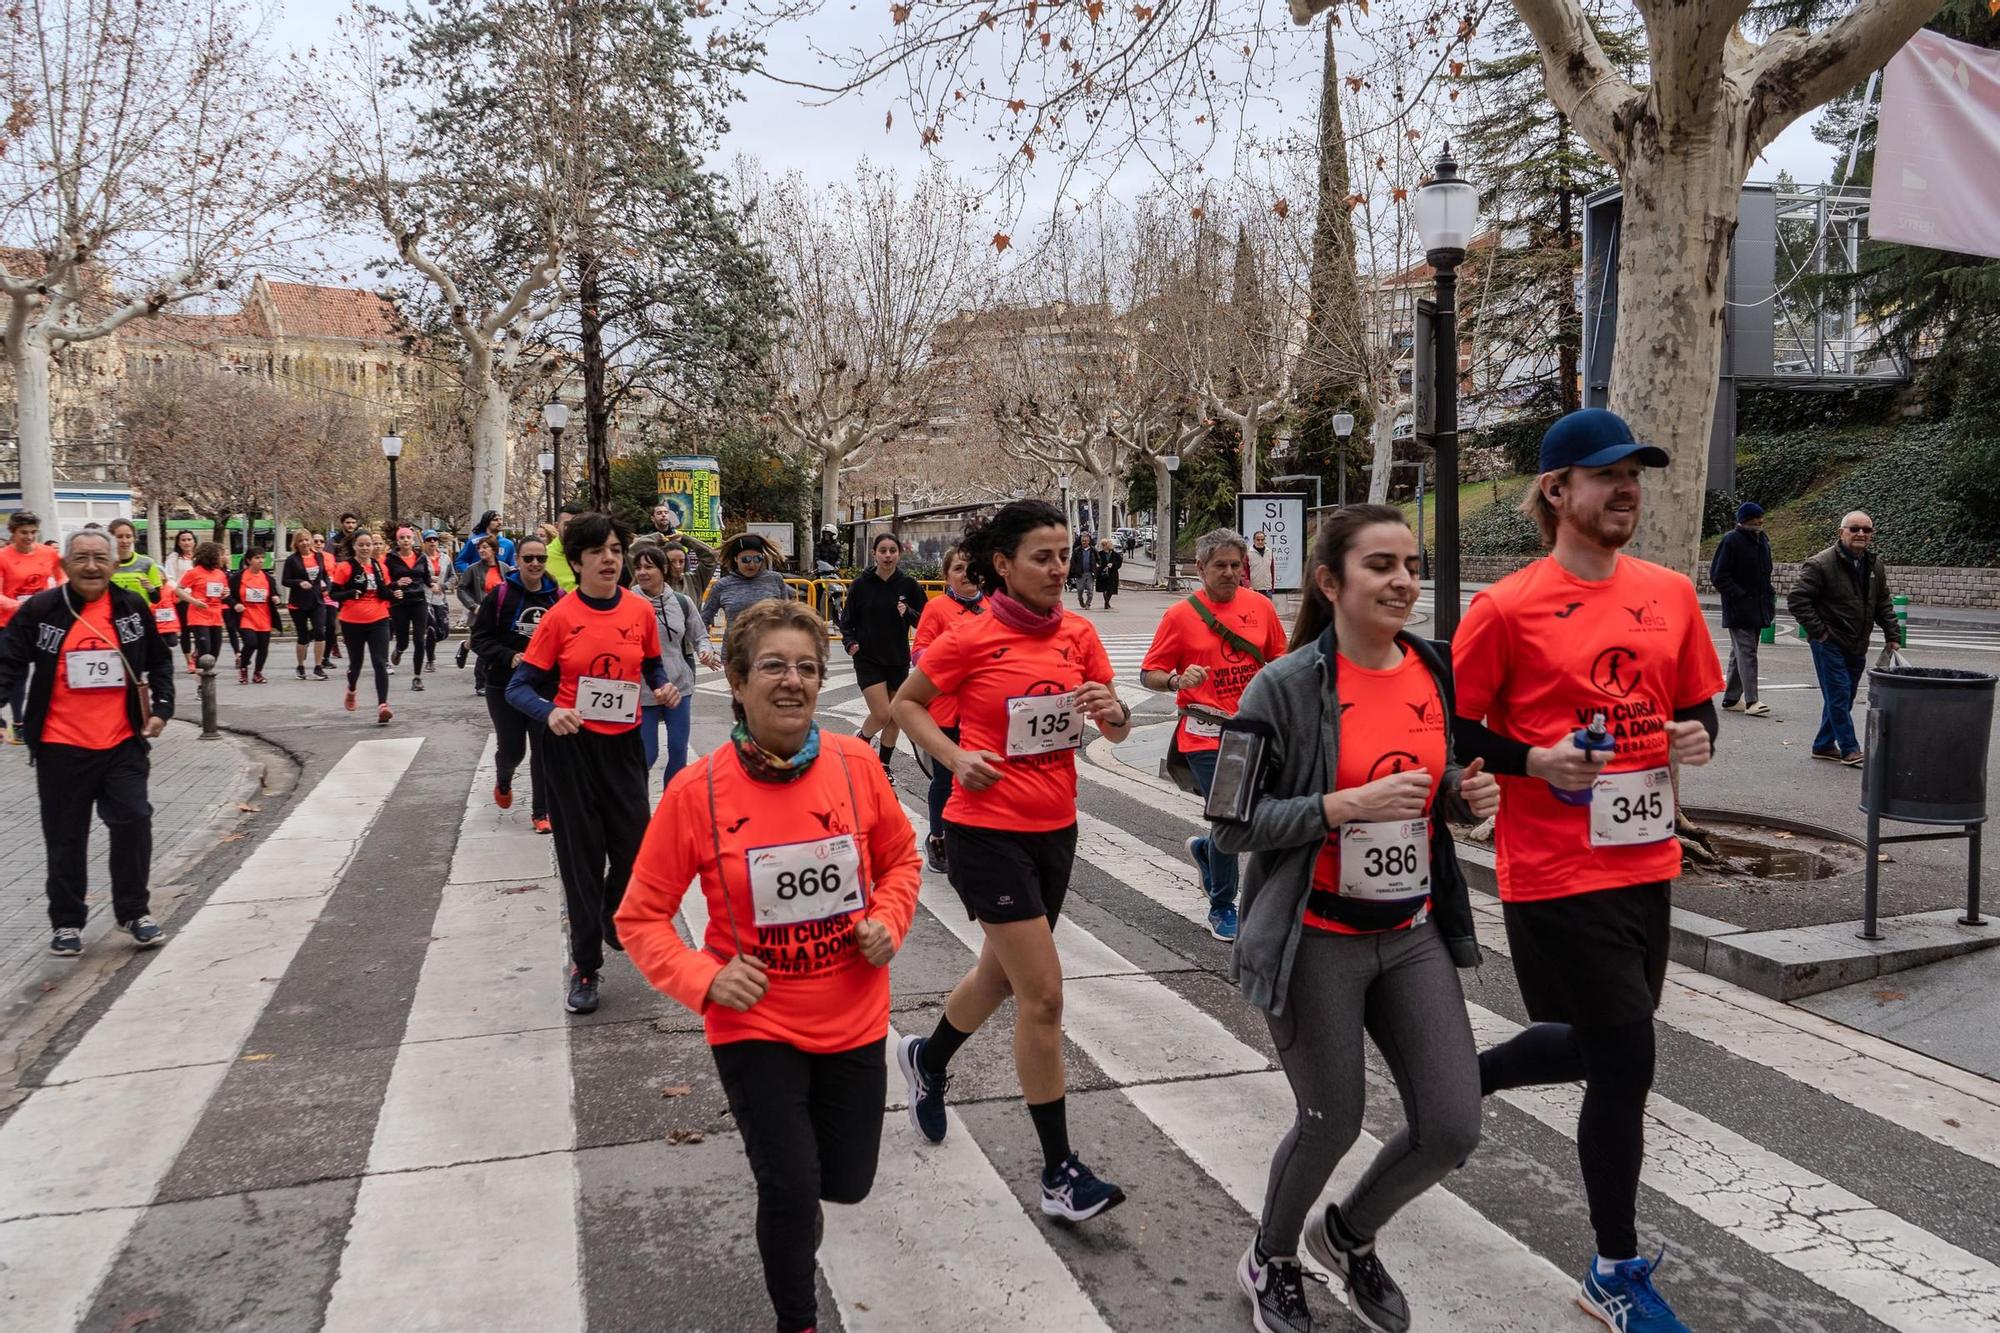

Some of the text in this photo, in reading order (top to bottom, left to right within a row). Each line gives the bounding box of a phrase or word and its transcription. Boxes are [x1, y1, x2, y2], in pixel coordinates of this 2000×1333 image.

[1265, 502, 1283, 518] SI
[1262, 521, 1285, 532] NO
[1265, 534, 1288, 545] TS
[86, 662, 109, 676] 79
[591, 691, 624, 710] 731
[1613, 700, 1656, 720] CURSA
[1027, 712, 1070, 737] 135
[1629, 715, 1665, 738] DONA
[1612, 792, 1663, 825] 345
[1363, 844, 1417, 878] 386
[776, 863, 841, 901] 866
[758, 914, 853, 946] VIII CURSA
[814, 928, 857, 959] DON
